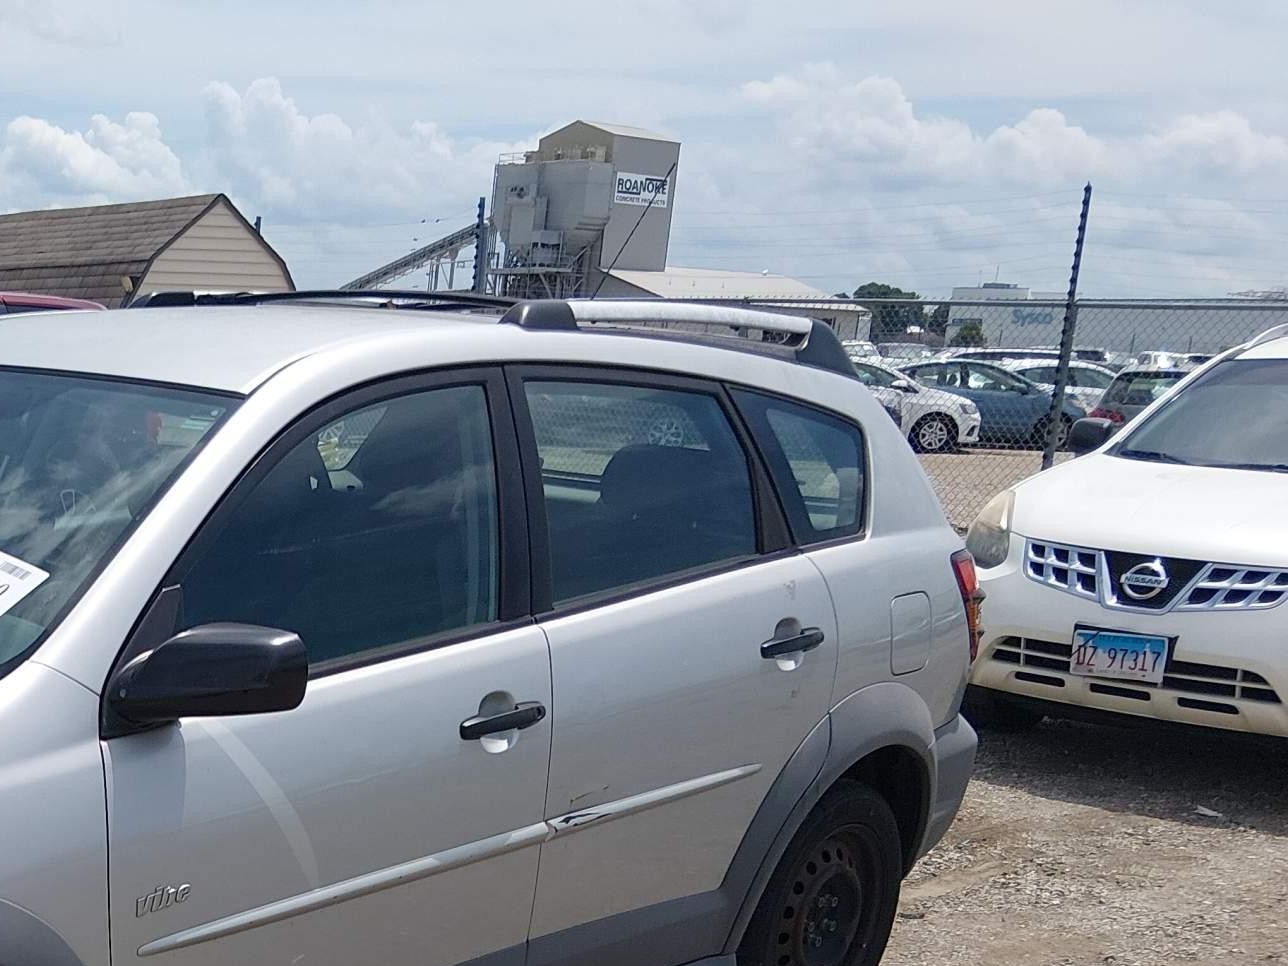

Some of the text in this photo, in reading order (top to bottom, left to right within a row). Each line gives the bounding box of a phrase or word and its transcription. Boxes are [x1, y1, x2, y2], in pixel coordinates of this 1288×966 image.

[617, 178, 667, 195] ROANOKE
[1011, 308, 1054, 327] Sysco
[1124, 574, 1161, 585] NISSAN
[1075, 645, 1162, 673] DZ 97317
[135, 883, 192, 918] vibe
